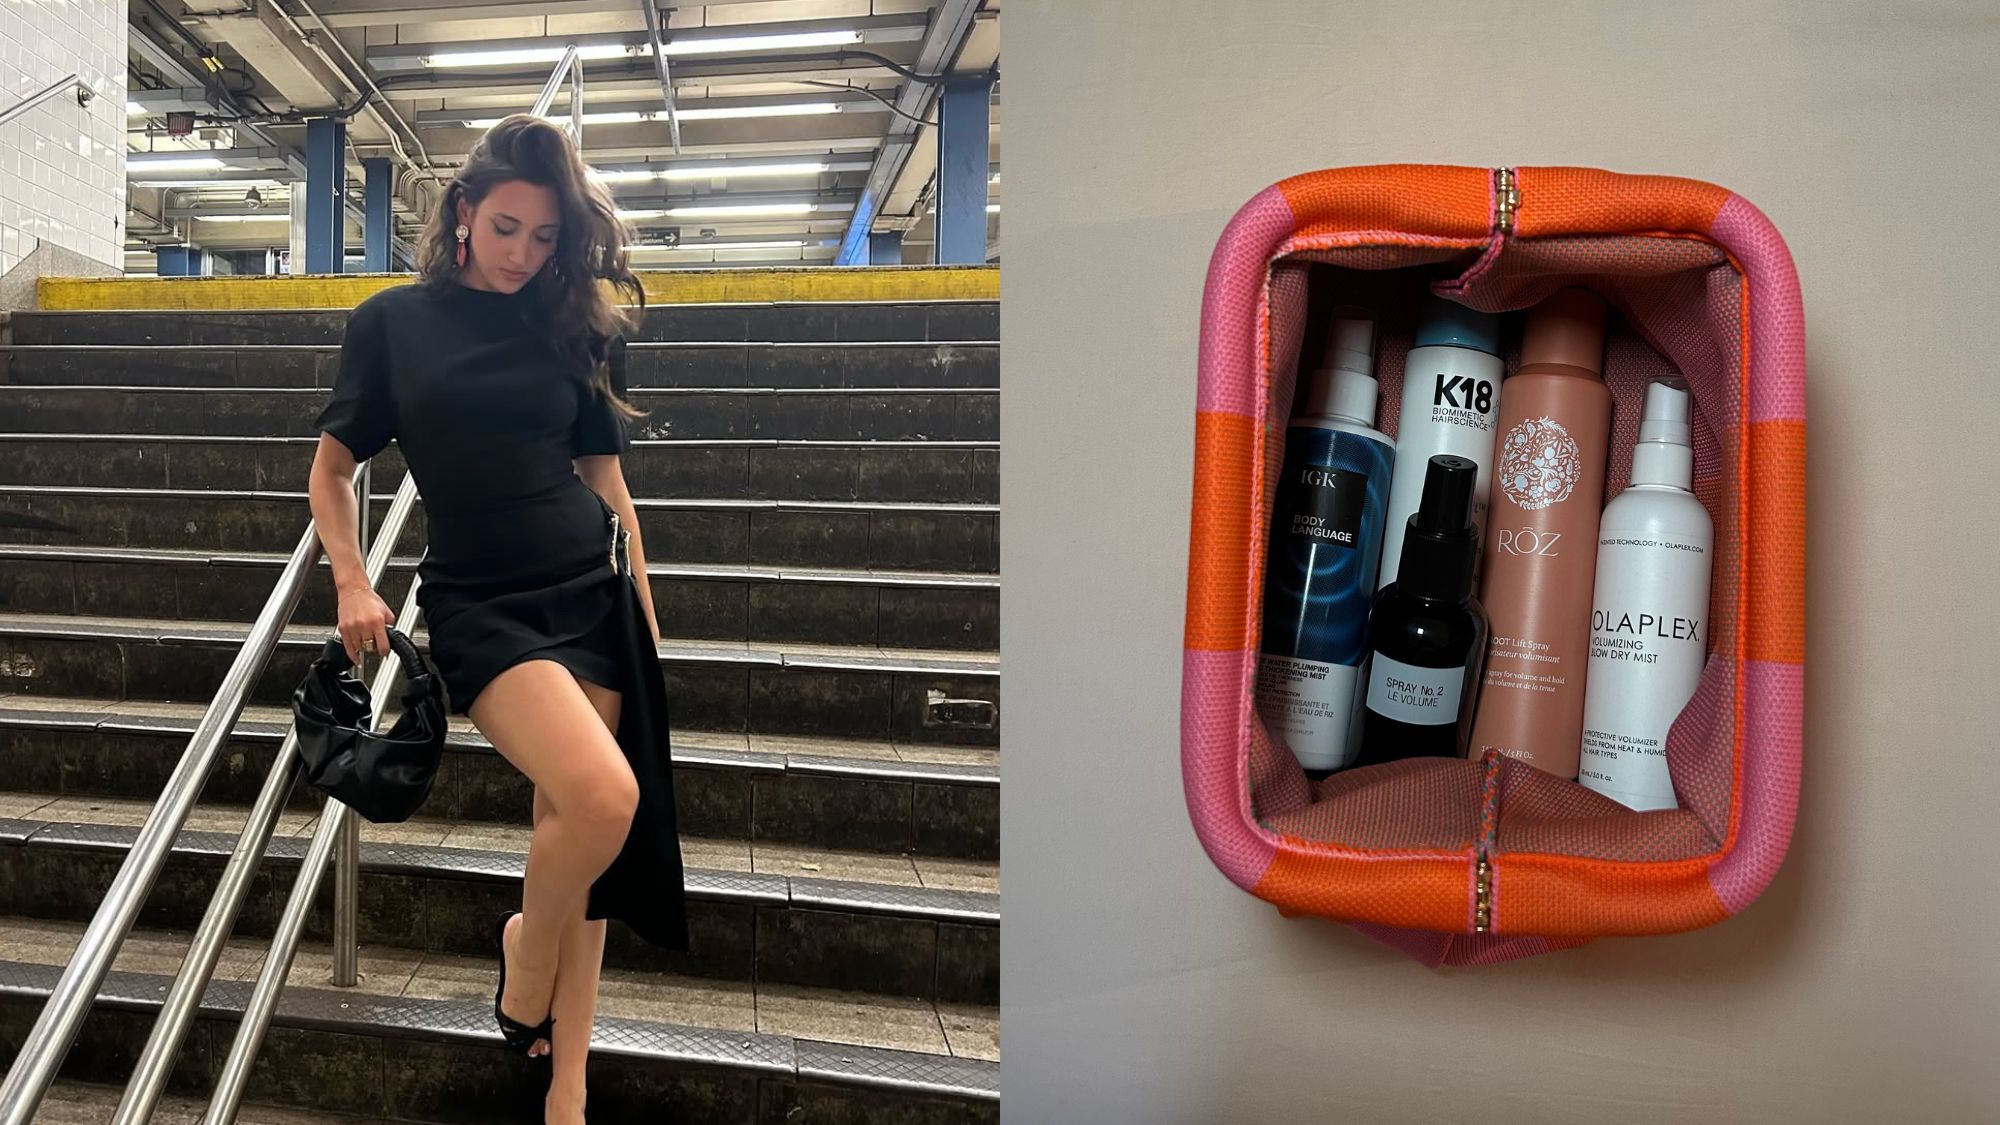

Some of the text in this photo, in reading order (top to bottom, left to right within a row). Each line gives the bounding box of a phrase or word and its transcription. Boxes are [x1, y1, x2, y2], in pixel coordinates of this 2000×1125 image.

[1433, 374, 1493, 414] K18
[1432, 407, 1485, 422] BIOMIMETIC
[1300, 469, 1337, 489] IGK
[1293, 514, 1326, 527] BODY
[1292, 524, 1353, 543] LANGUAGE
[1497, 526, 1562, 557] RŌZ
[1617, 538, 1657, 547] TECHNOLOGY
[1665, 542, 1704, 553] OLAPLEX.COM
[1492, 636, 1550, 652] OOT Lift Spray
[1592, 636, 1644, 650] VOLUMIZING
[1519, 651, 1561, 664] volumisant
[1610, 649, 1631, 661] DRY
[1633, 652, 1659, 664] MIST
[1266, 665, 1308, 678] THICKENING
[1309, 671, 1327, 680] MIST
[1267, 658, 1291, 668] WATER
[1292, 662, 1330, 674] PLUMPING
[1495, 679, 1516, 688] volume
[1523, 682, 1532, 690] de
[1504, 670, 1513, 678] for
[1514, 671, 1538, 681] volume
[1538, 675, 1551, 683] and
[1552, 675, 1565, 685] hold
[1386, 677, 1444, 696] SPRAY No. 2
[1387, 690, 1439, 708] LE VOLUME
[1598, 741, 1616, 750] FROM
[1617, 744, 1634, 753] HEAT
[1636, 746, 1642, 754] &
[1618, 735, 1658, 747] VOLUMIZER
[1601, 750, 1617, 760] TYPES
